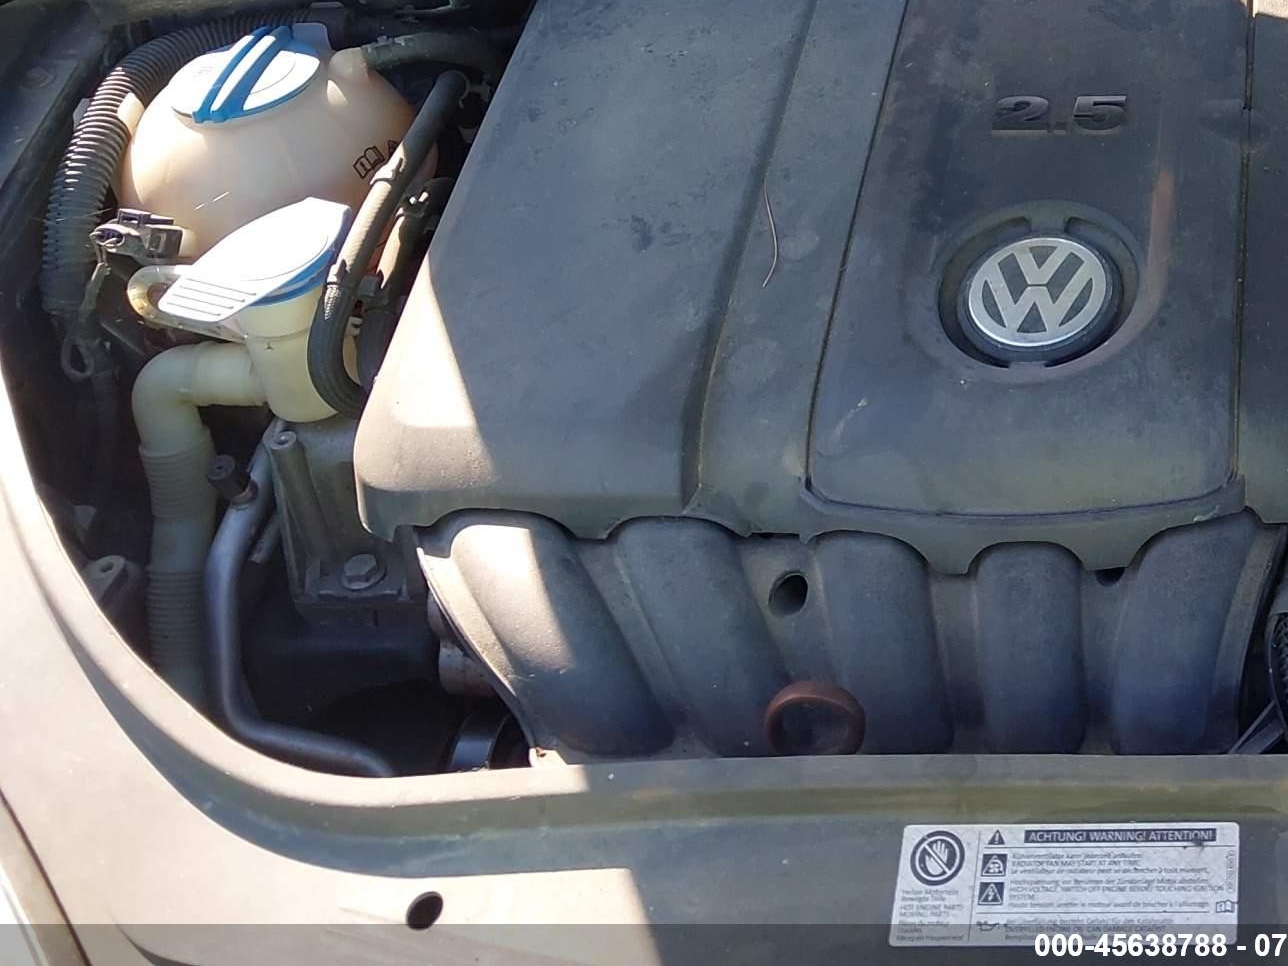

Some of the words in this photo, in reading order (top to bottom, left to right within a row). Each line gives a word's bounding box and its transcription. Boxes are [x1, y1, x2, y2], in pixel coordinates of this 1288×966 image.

[991, 95, 1127, 138] 2.5
[1028, 831, 1087, 843] ACHTUNG!
[1089, 830, 1148, 842] WARNING!
[1149, 830, 1214, 841] ATTENTION!
